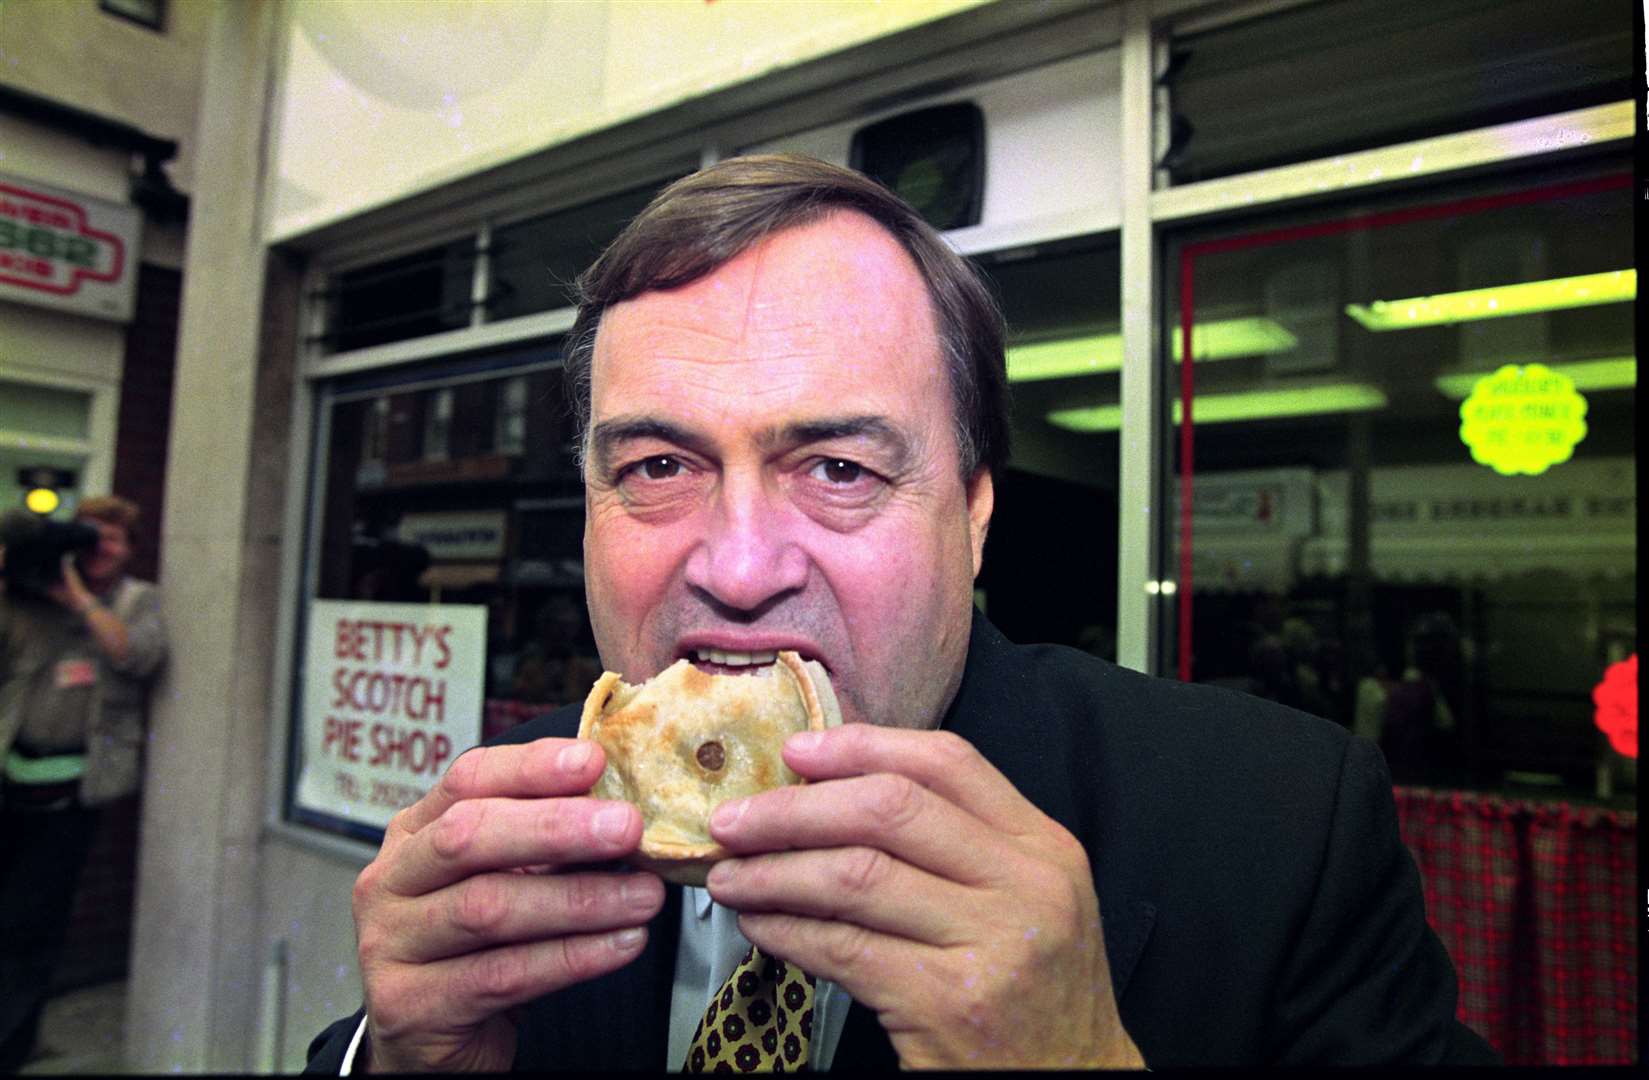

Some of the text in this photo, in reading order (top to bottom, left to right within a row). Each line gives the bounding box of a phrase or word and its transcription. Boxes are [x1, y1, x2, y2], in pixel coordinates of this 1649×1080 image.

[335, 618, 452, 669] BETTY'S
[332, 668, 446, 721] SCOTCH
[322, 716, 451, 775] PIE SHOP
